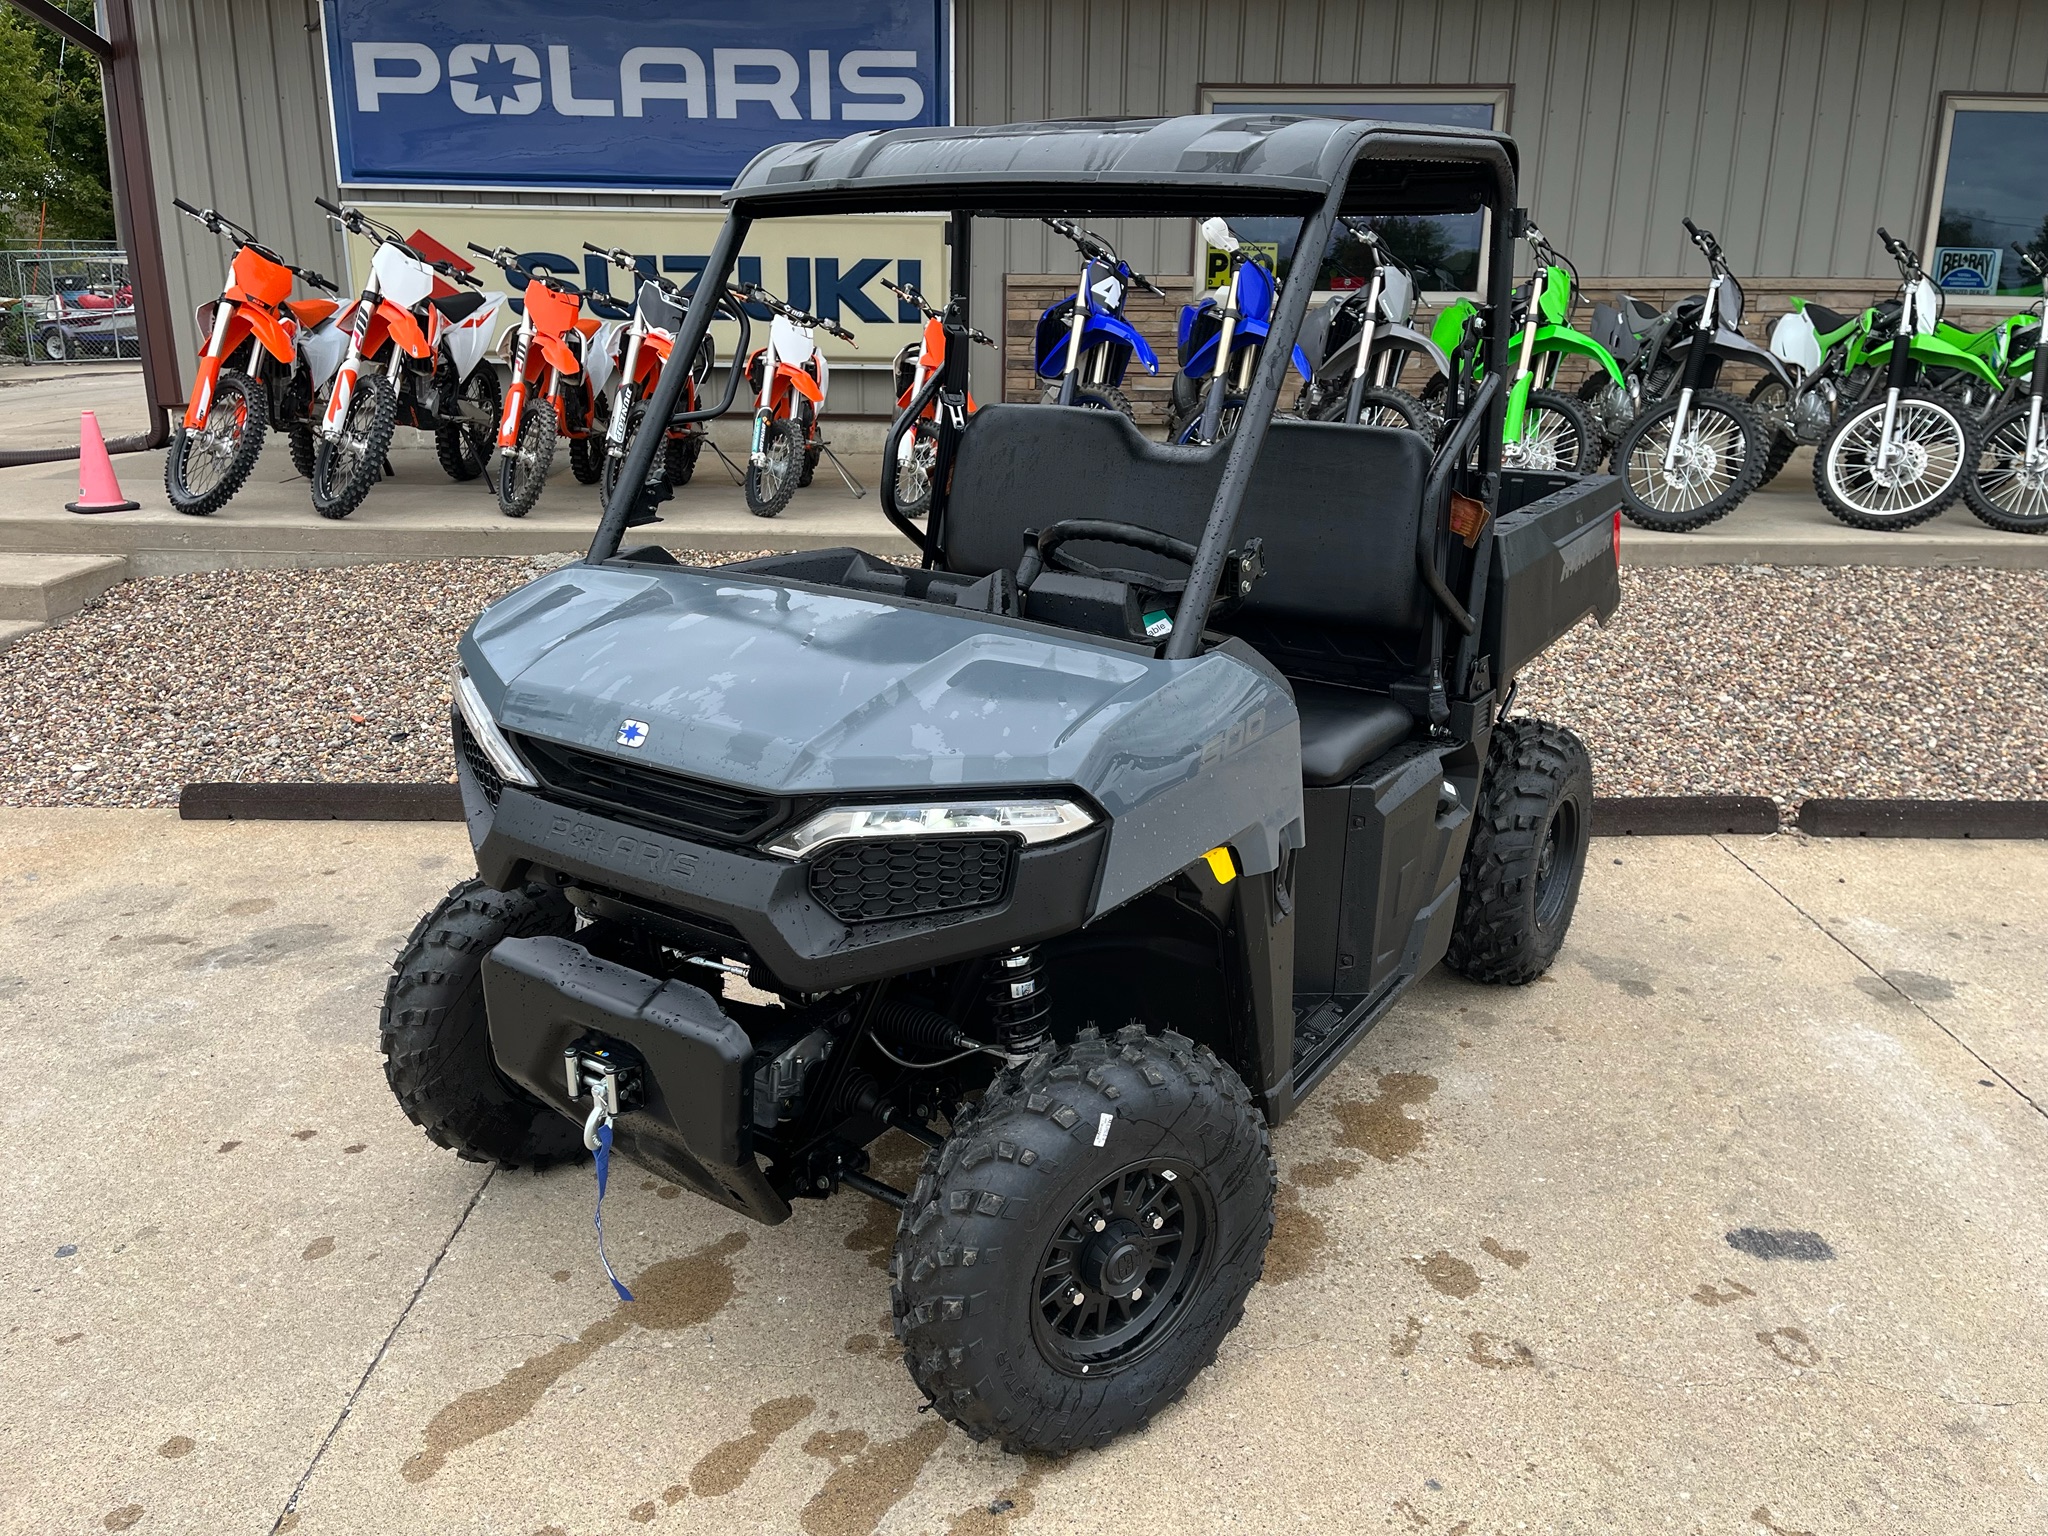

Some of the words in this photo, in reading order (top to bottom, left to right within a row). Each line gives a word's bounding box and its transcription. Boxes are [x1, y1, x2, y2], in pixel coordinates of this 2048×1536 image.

[351, 41, 925, 121] POLARIS
[1091, 275, 1122, 309] 4
[614, 387, 633, 442] DUNLOP
[551, 815, 700, 882] POLARIS
